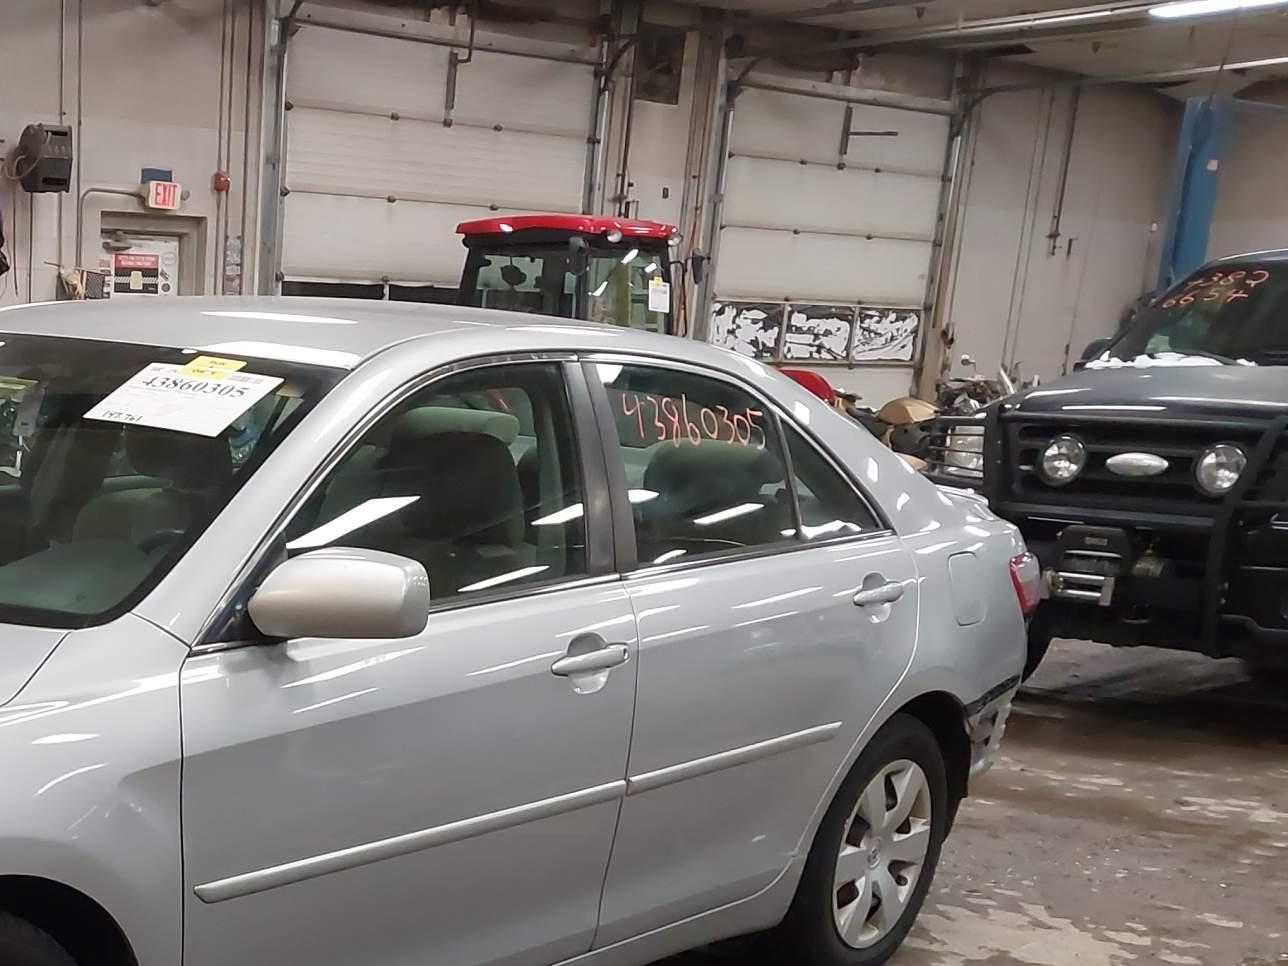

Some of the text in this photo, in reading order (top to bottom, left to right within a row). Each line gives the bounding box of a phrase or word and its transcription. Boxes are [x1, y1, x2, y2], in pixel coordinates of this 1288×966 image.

[155, 183, 178, 206] EXIT
[143, 376, 251, 398] 43860305
[622, 394, 765, 449] 43860305
